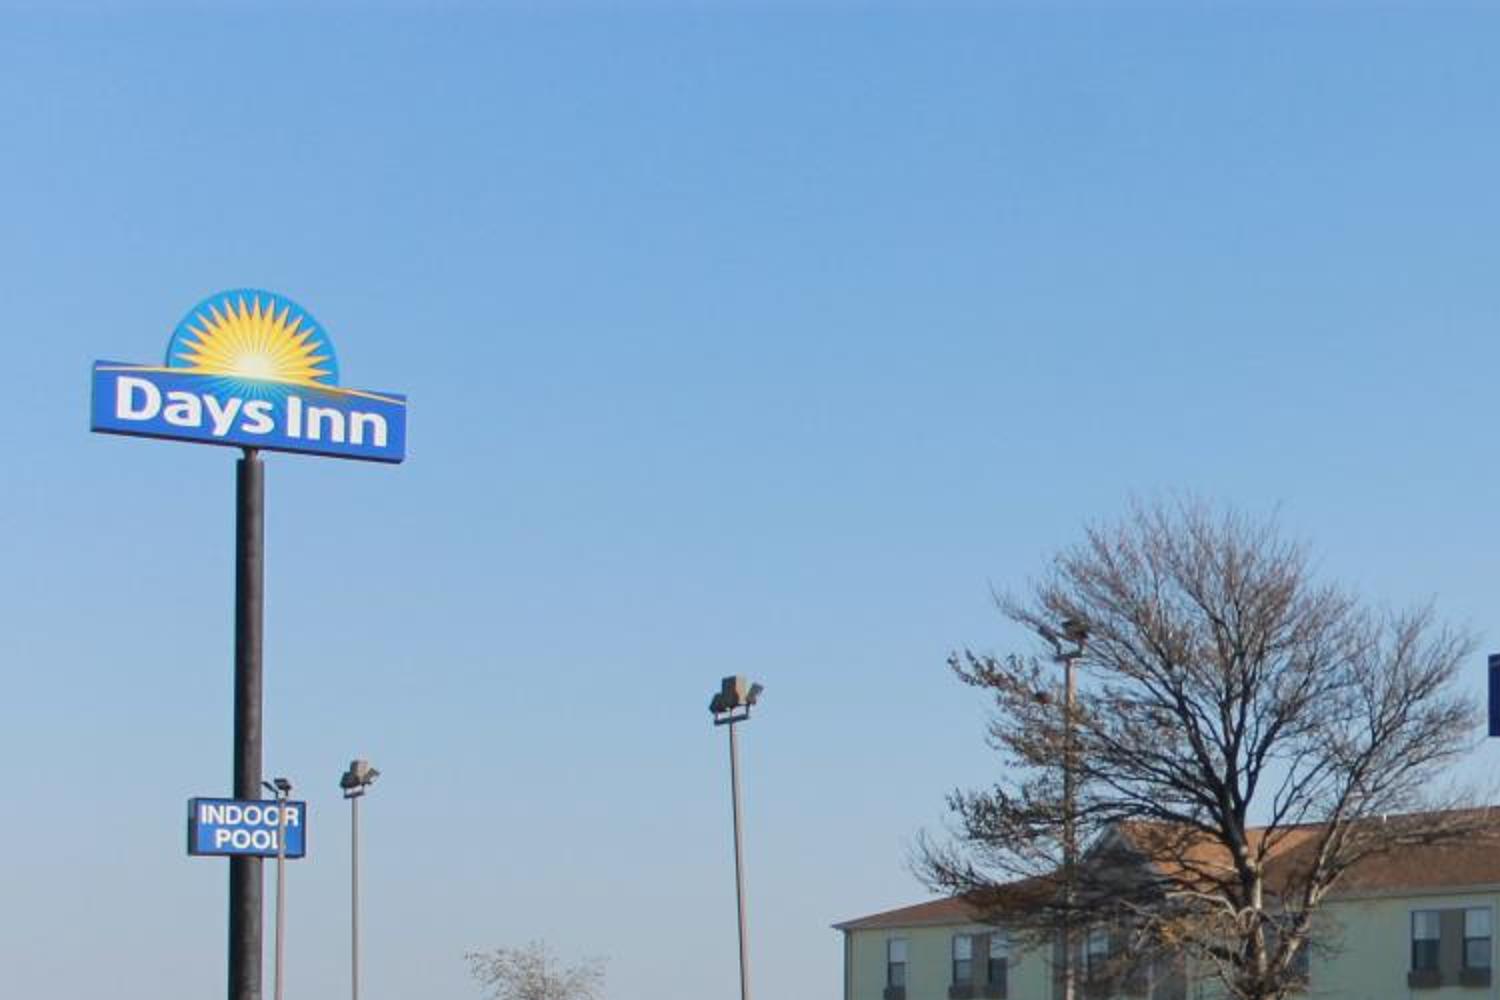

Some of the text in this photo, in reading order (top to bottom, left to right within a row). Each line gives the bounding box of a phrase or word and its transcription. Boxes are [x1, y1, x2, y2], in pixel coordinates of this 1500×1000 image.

[116, 376, 388, 447] Days Inn
[201, 805, 299, 827] INDOOR
